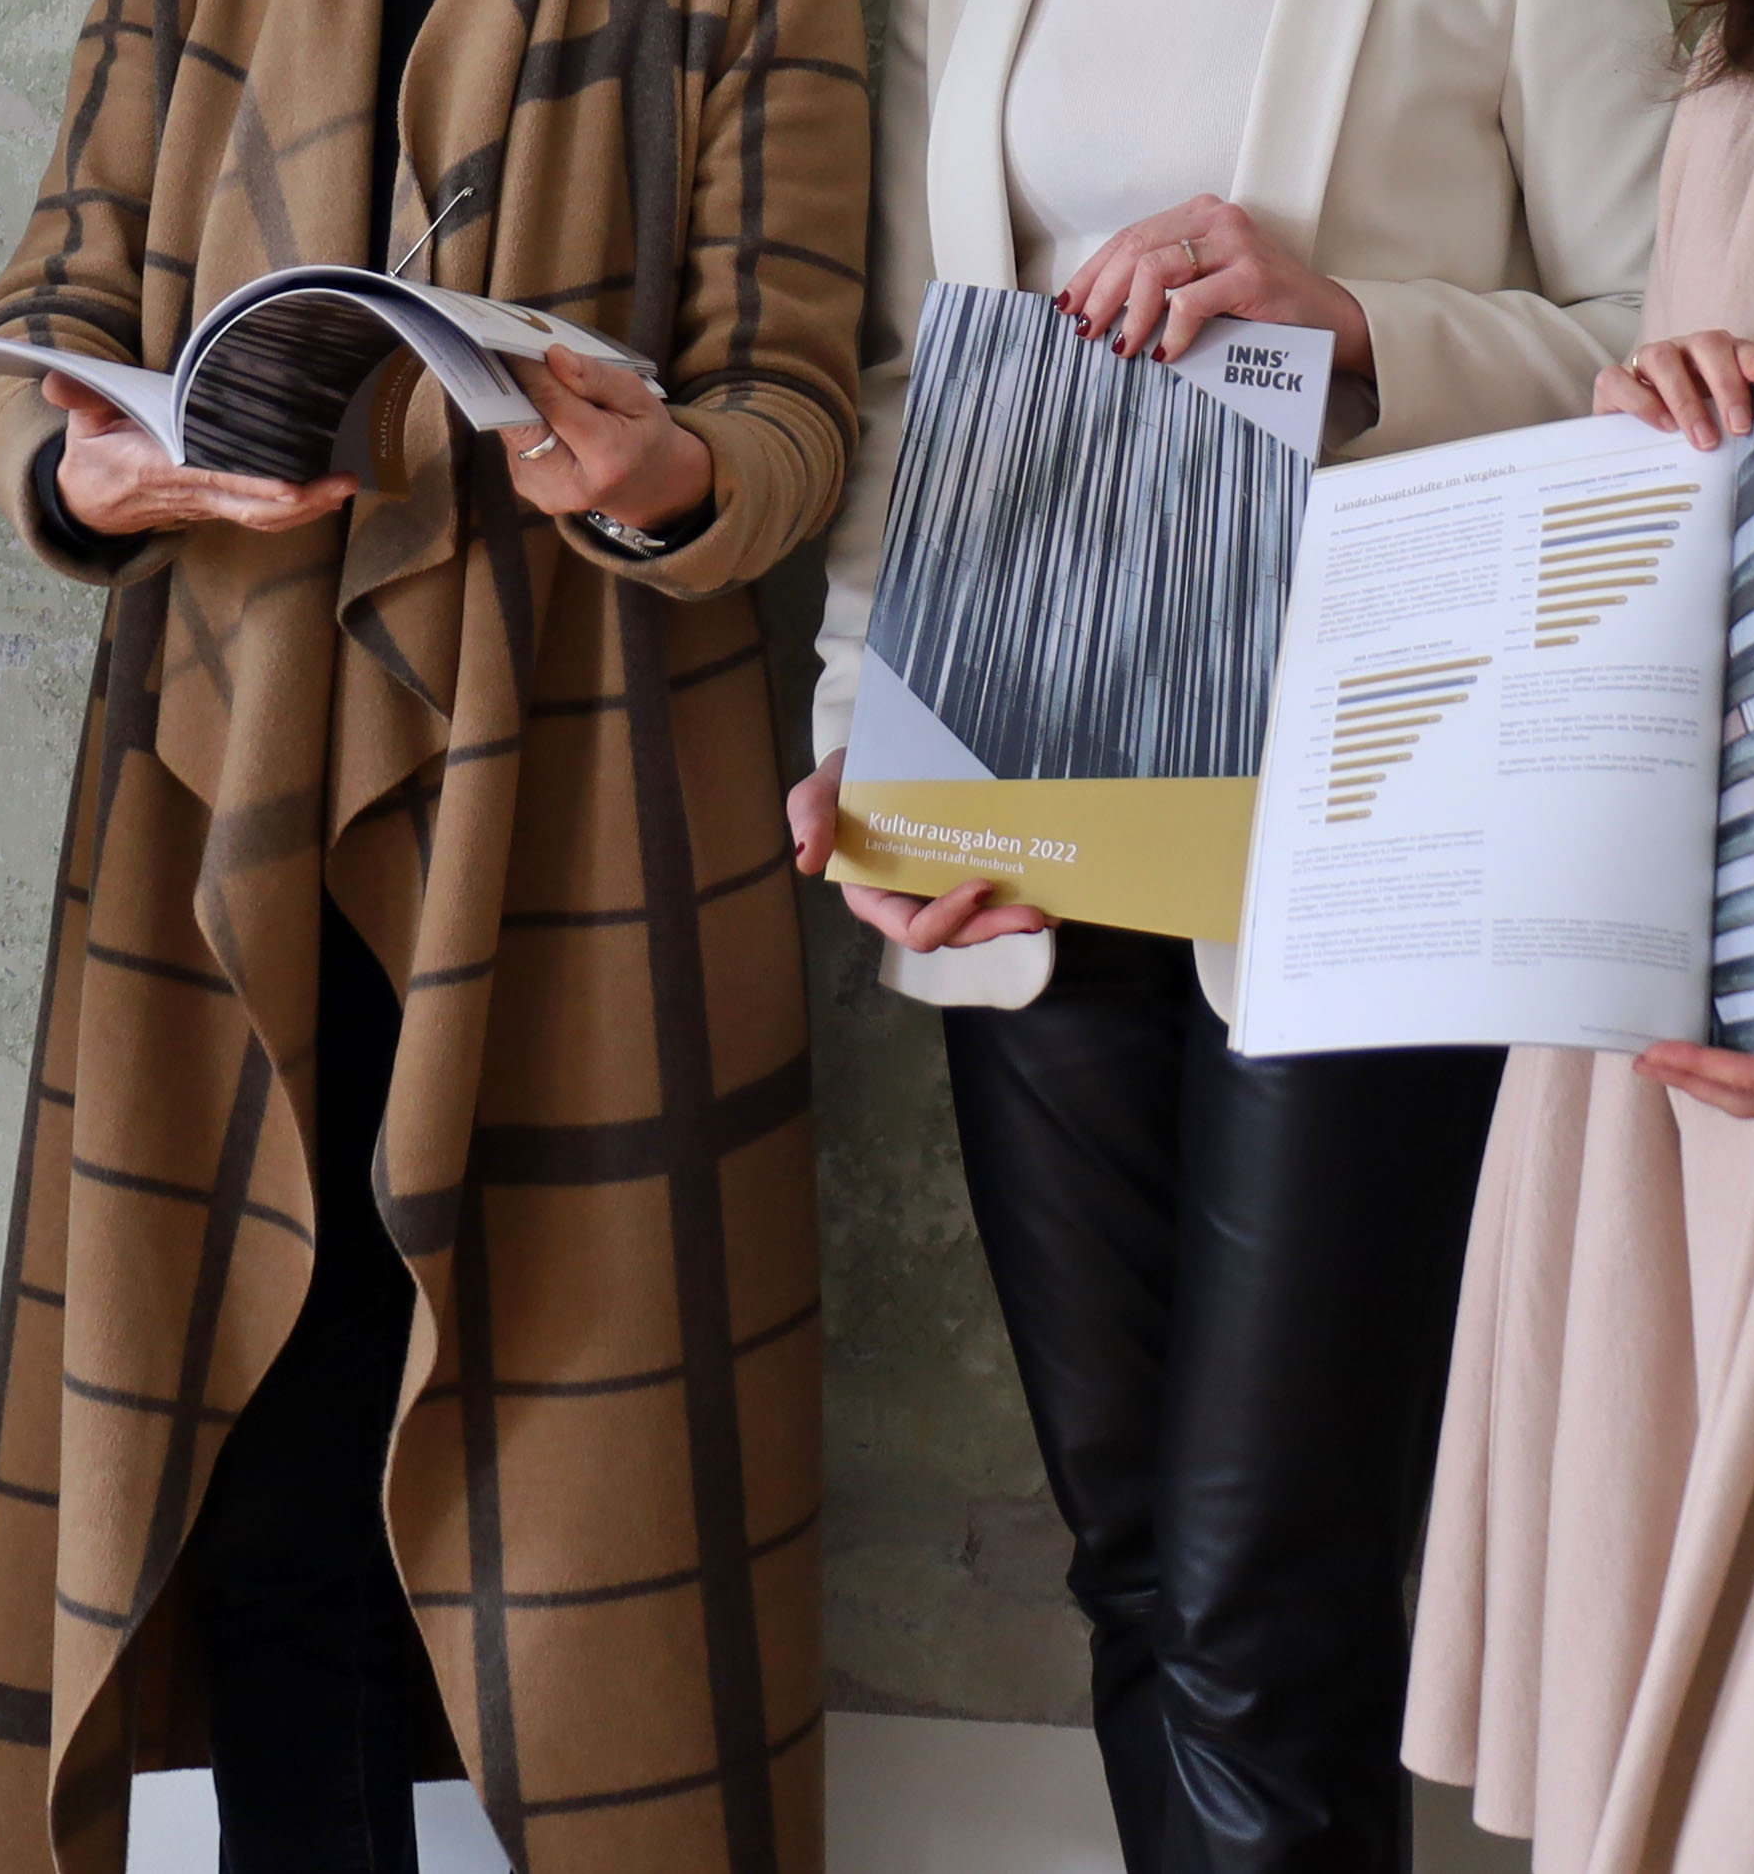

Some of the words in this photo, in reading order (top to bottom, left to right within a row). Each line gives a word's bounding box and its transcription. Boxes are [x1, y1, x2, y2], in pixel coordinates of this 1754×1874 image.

[1224, 365, 1303, 393] BRUCK
[1333, 478, 1443, 514] Landeshauptstädte
[1445, 477, 1462, 489] im
[1463, 463, 1517, 485] Vergleich
[865, 838, 966, 866] Landeshauptstadt
[969, 855, 1025, 875] Innsbruck
[868, 811, 1022, 855] Kulturausgaben
[1028, 837, 1078, 863] 2022
